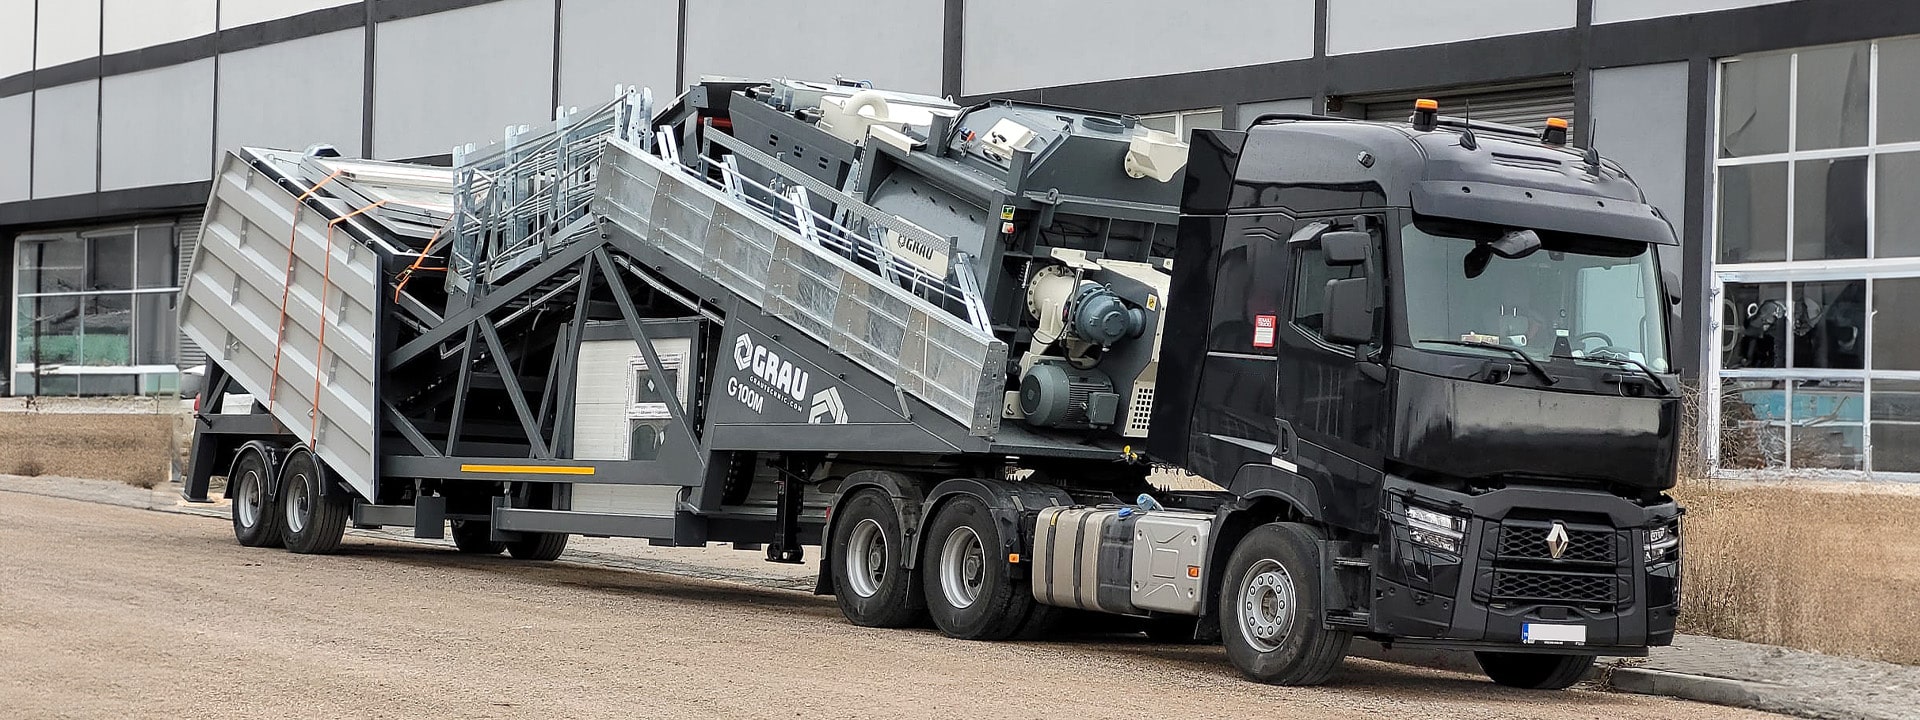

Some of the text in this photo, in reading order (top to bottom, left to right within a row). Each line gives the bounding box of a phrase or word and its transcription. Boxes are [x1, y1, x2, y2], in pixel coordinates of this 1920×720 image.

[906, 238, 934, 260] GRAU
[753, 345, 809, 401] GRAU
[728, 377, 764, 414] G100M
